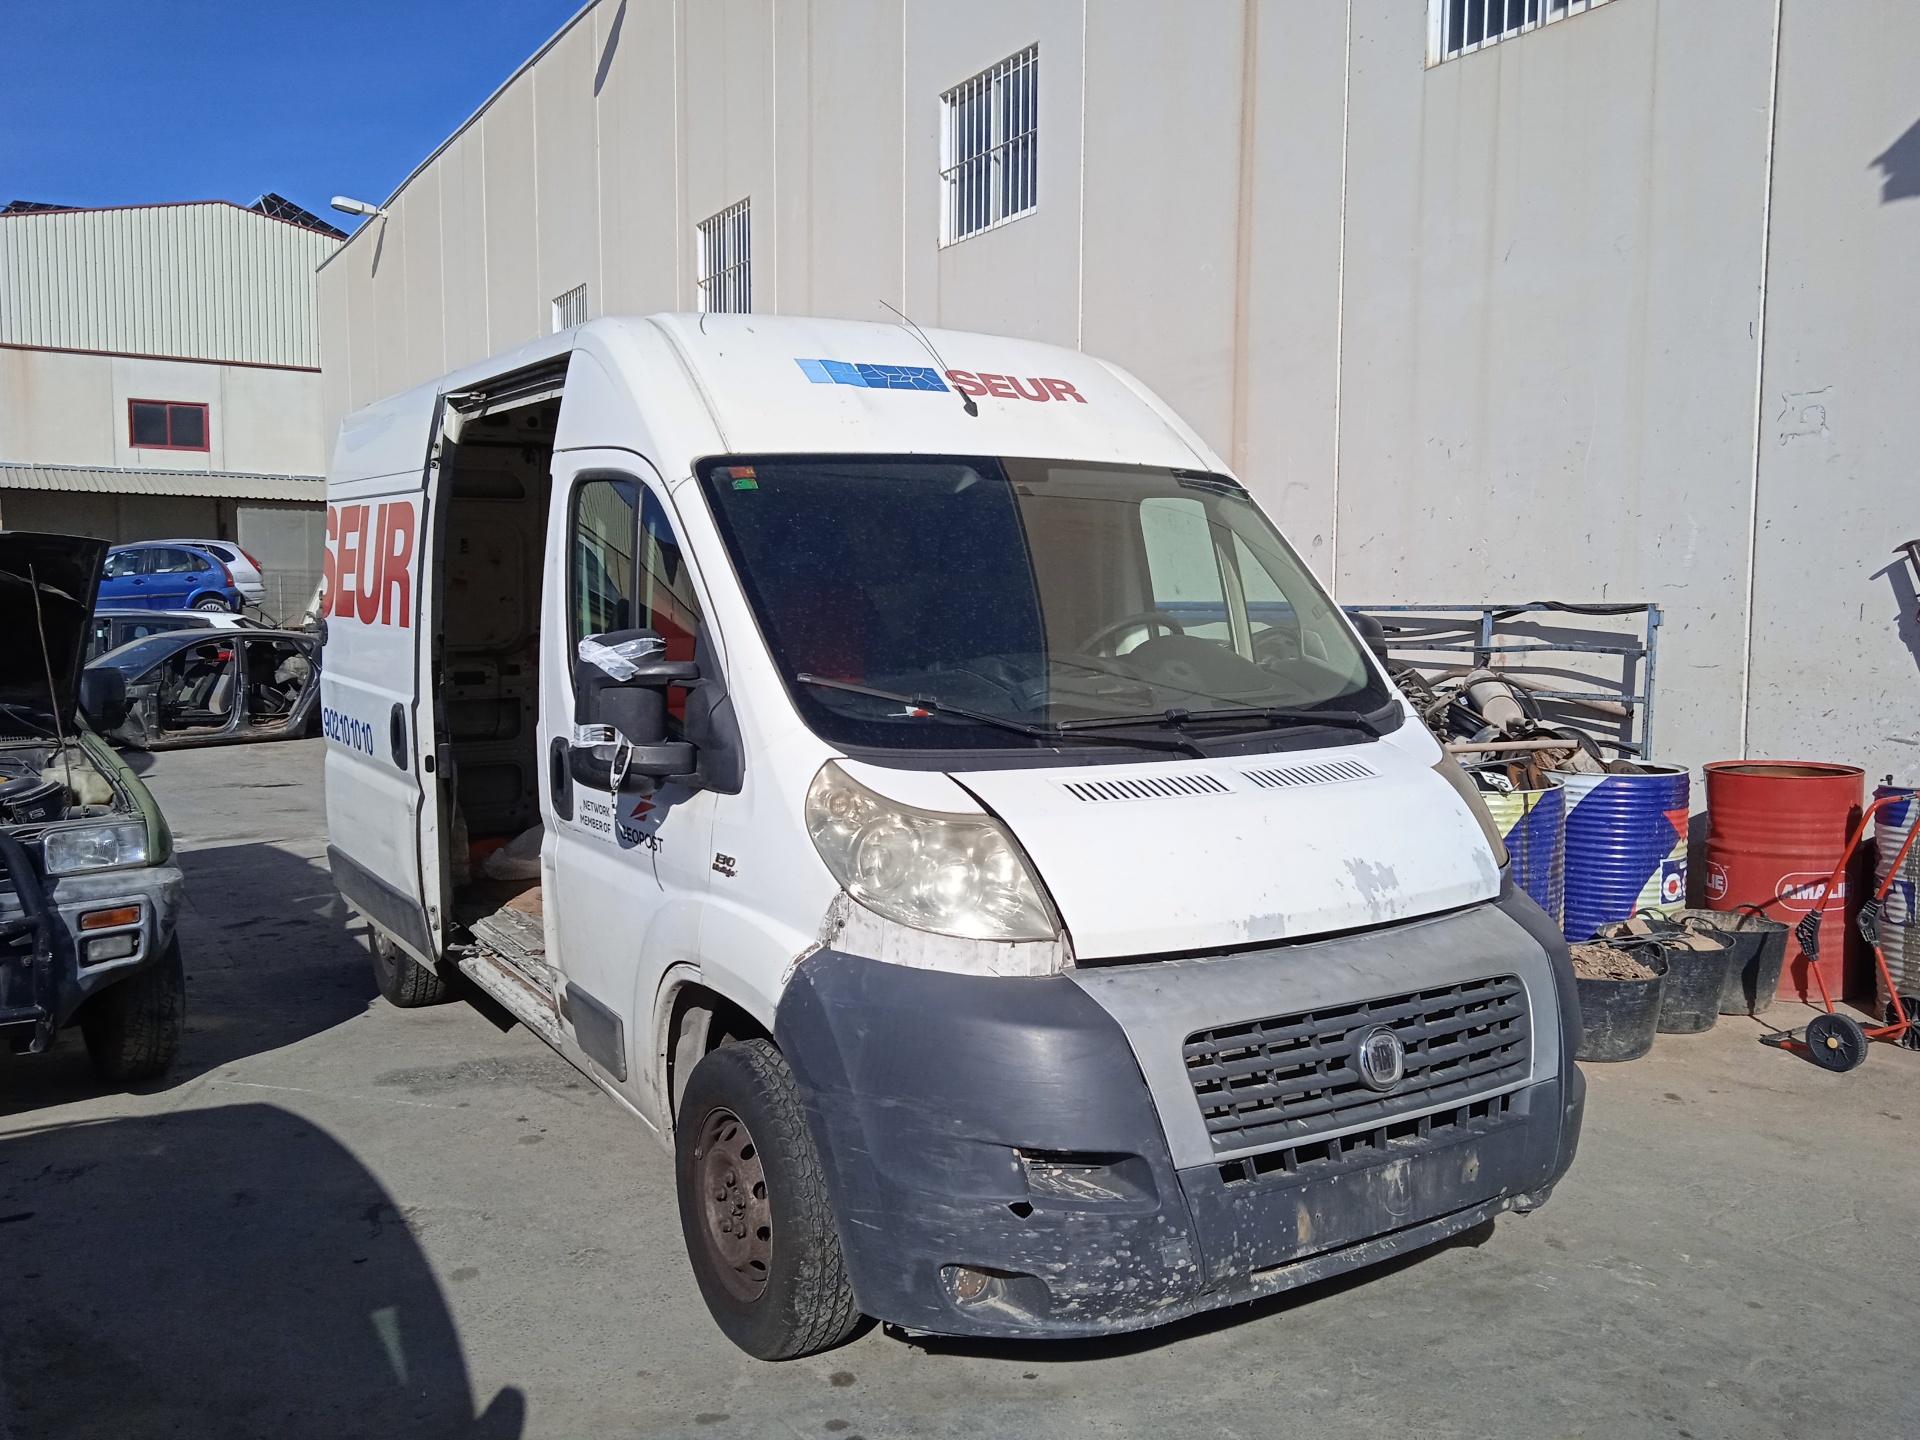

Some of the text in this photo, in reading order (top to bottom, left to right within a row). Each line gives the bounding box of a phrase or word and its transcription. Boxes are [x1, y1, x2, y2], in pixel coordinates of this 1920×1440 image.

[945, 369, 1088, 404] SEUR
[322, 501, 415, 628] SEUR
[582, 799, 611, 817] NETWORK
[580, 813, 612, 834] MEMBER OF
[620, 824, 664, 854] GEOPOST
[1780, 881, 1852, 900] AMALIE
